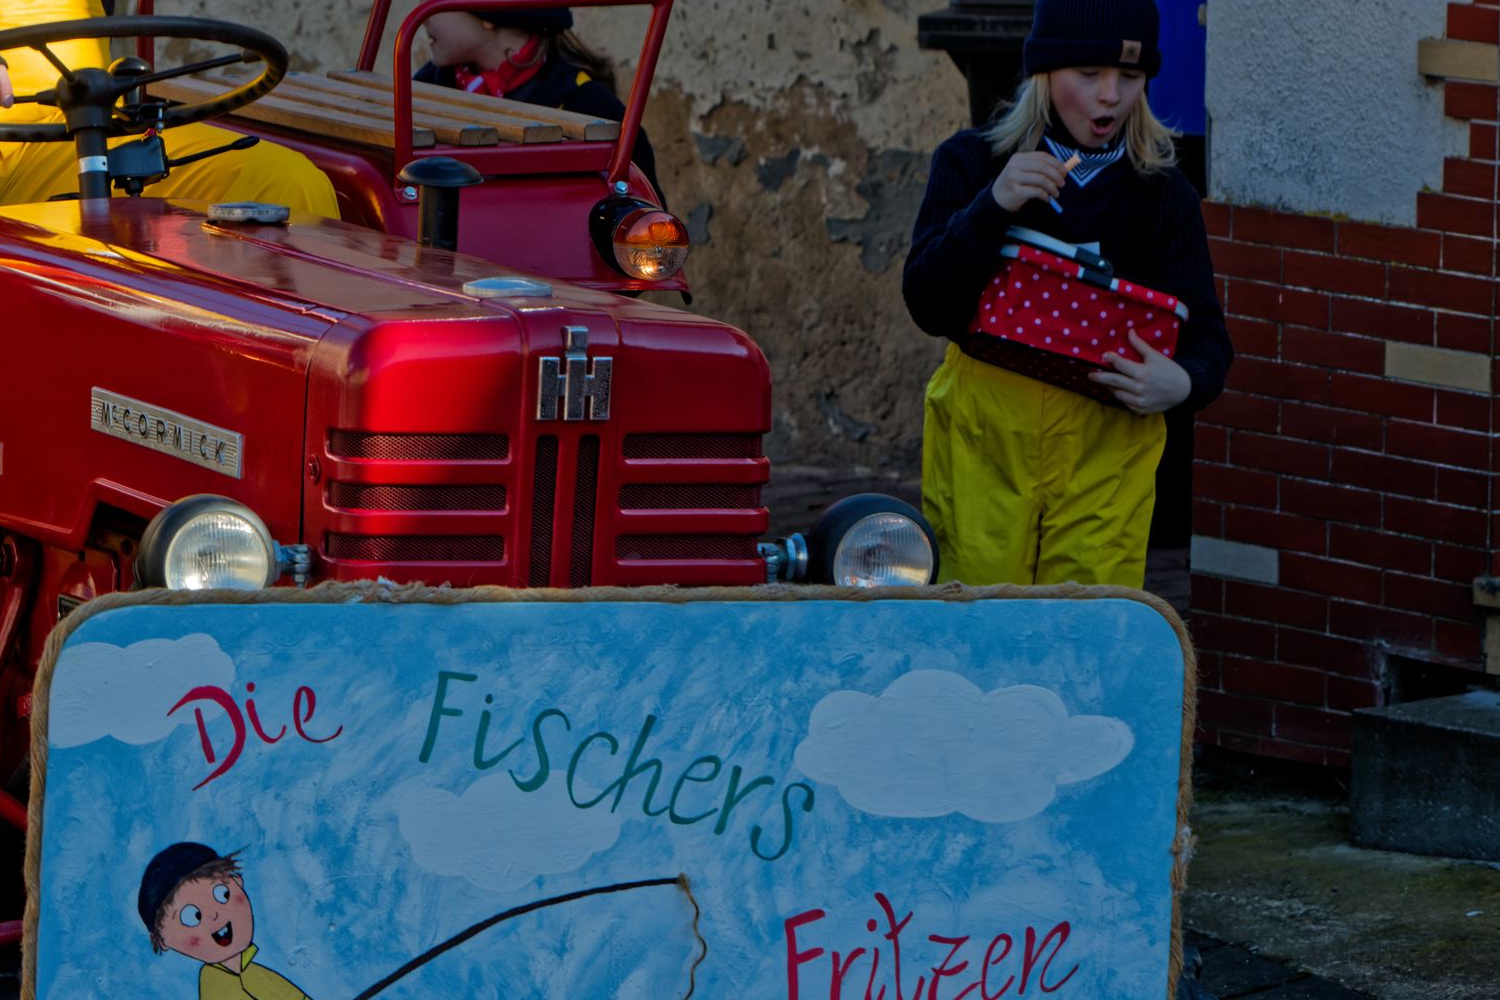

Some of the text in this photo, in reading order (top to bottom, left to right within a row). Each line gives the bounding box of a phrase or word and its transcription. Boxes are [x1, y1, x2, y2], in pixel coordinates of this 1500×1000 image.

[167, 670, 814, 861] Die Fischers
[784, 891, 1080, 999] Fritzen
